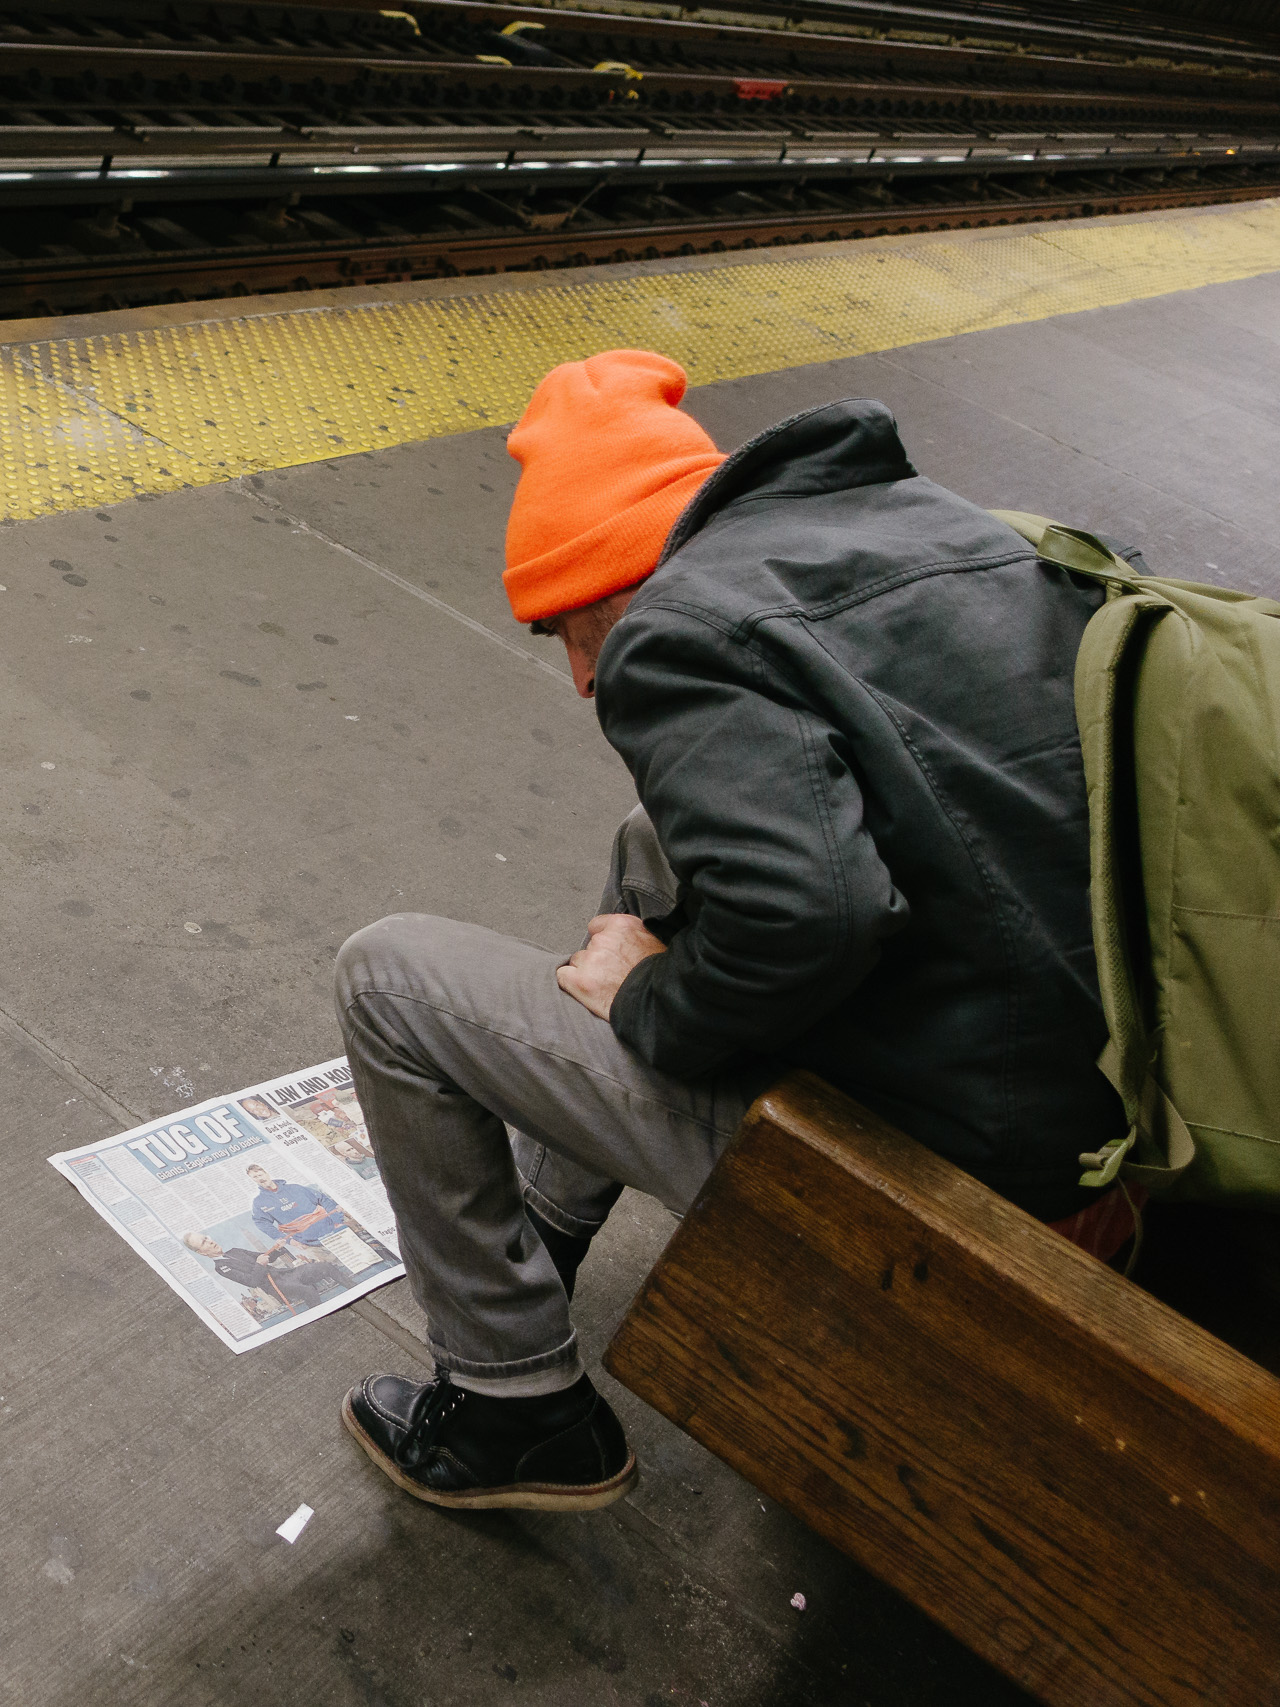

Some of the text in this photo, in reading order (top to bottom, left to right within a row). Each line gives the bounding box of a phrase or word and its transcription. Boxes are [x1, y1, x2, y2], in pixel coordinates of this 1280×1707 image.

[265, 1084, 302, 1106] LAW
[297, 1076, 330, 1095] AND
[127, 1124, 210, 1169] TUG
[195, 1106, 245, 1145] OF
[283, 1134, 308, 1147] slaying
[156, 1164, 189, 1181] Giants,
[184, 1154, 213, 1170] Eagles
[212, 1147, 232, 1160] may
[228, 1144, 241, 1153] do
[240, 1135, 264, 1149] battle
